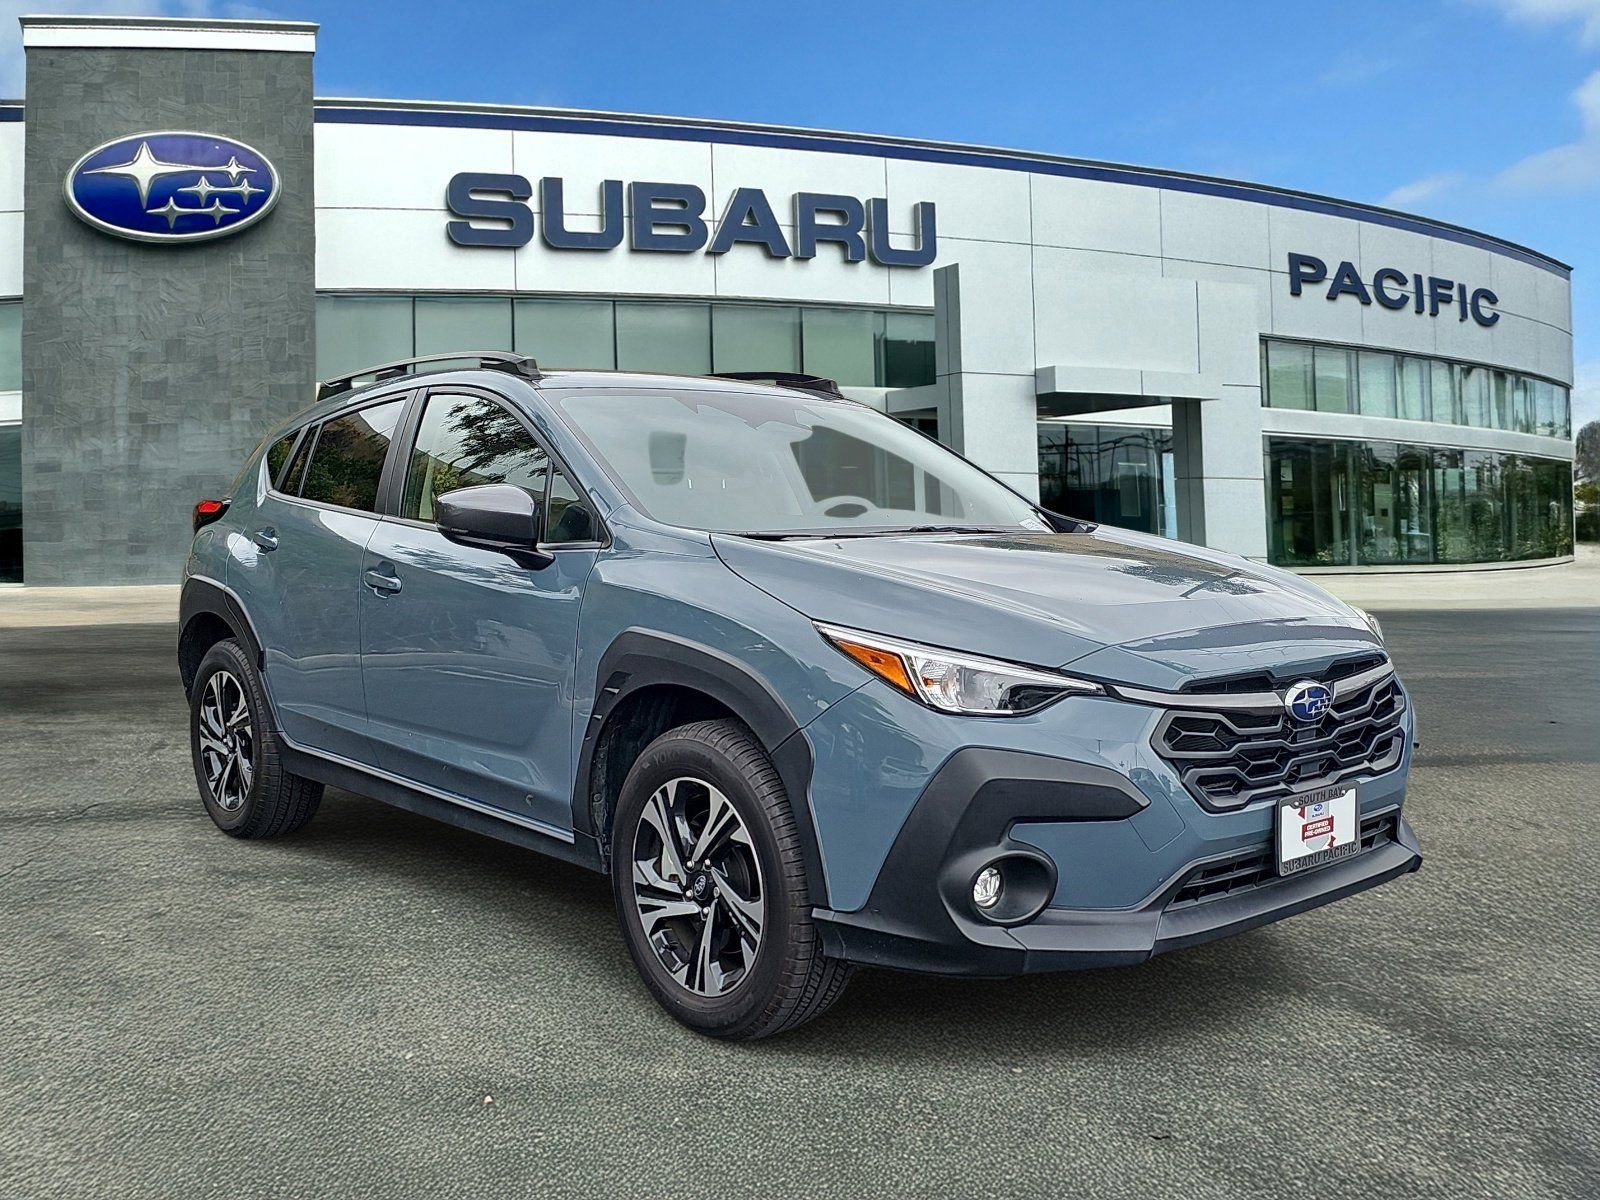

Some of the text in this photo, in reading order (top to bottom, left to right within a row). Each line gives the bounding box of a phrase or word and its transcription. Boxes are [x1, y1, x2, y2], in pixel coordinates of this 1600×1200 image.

[446, 171, 937, 268] SUBARU
[1288, 252, 1500, 327] PACIFIC
[1298, 787, 1343, 805] SOUTH BAY
[1283, 842, 1358, 873] SUBARU PACIFIC
